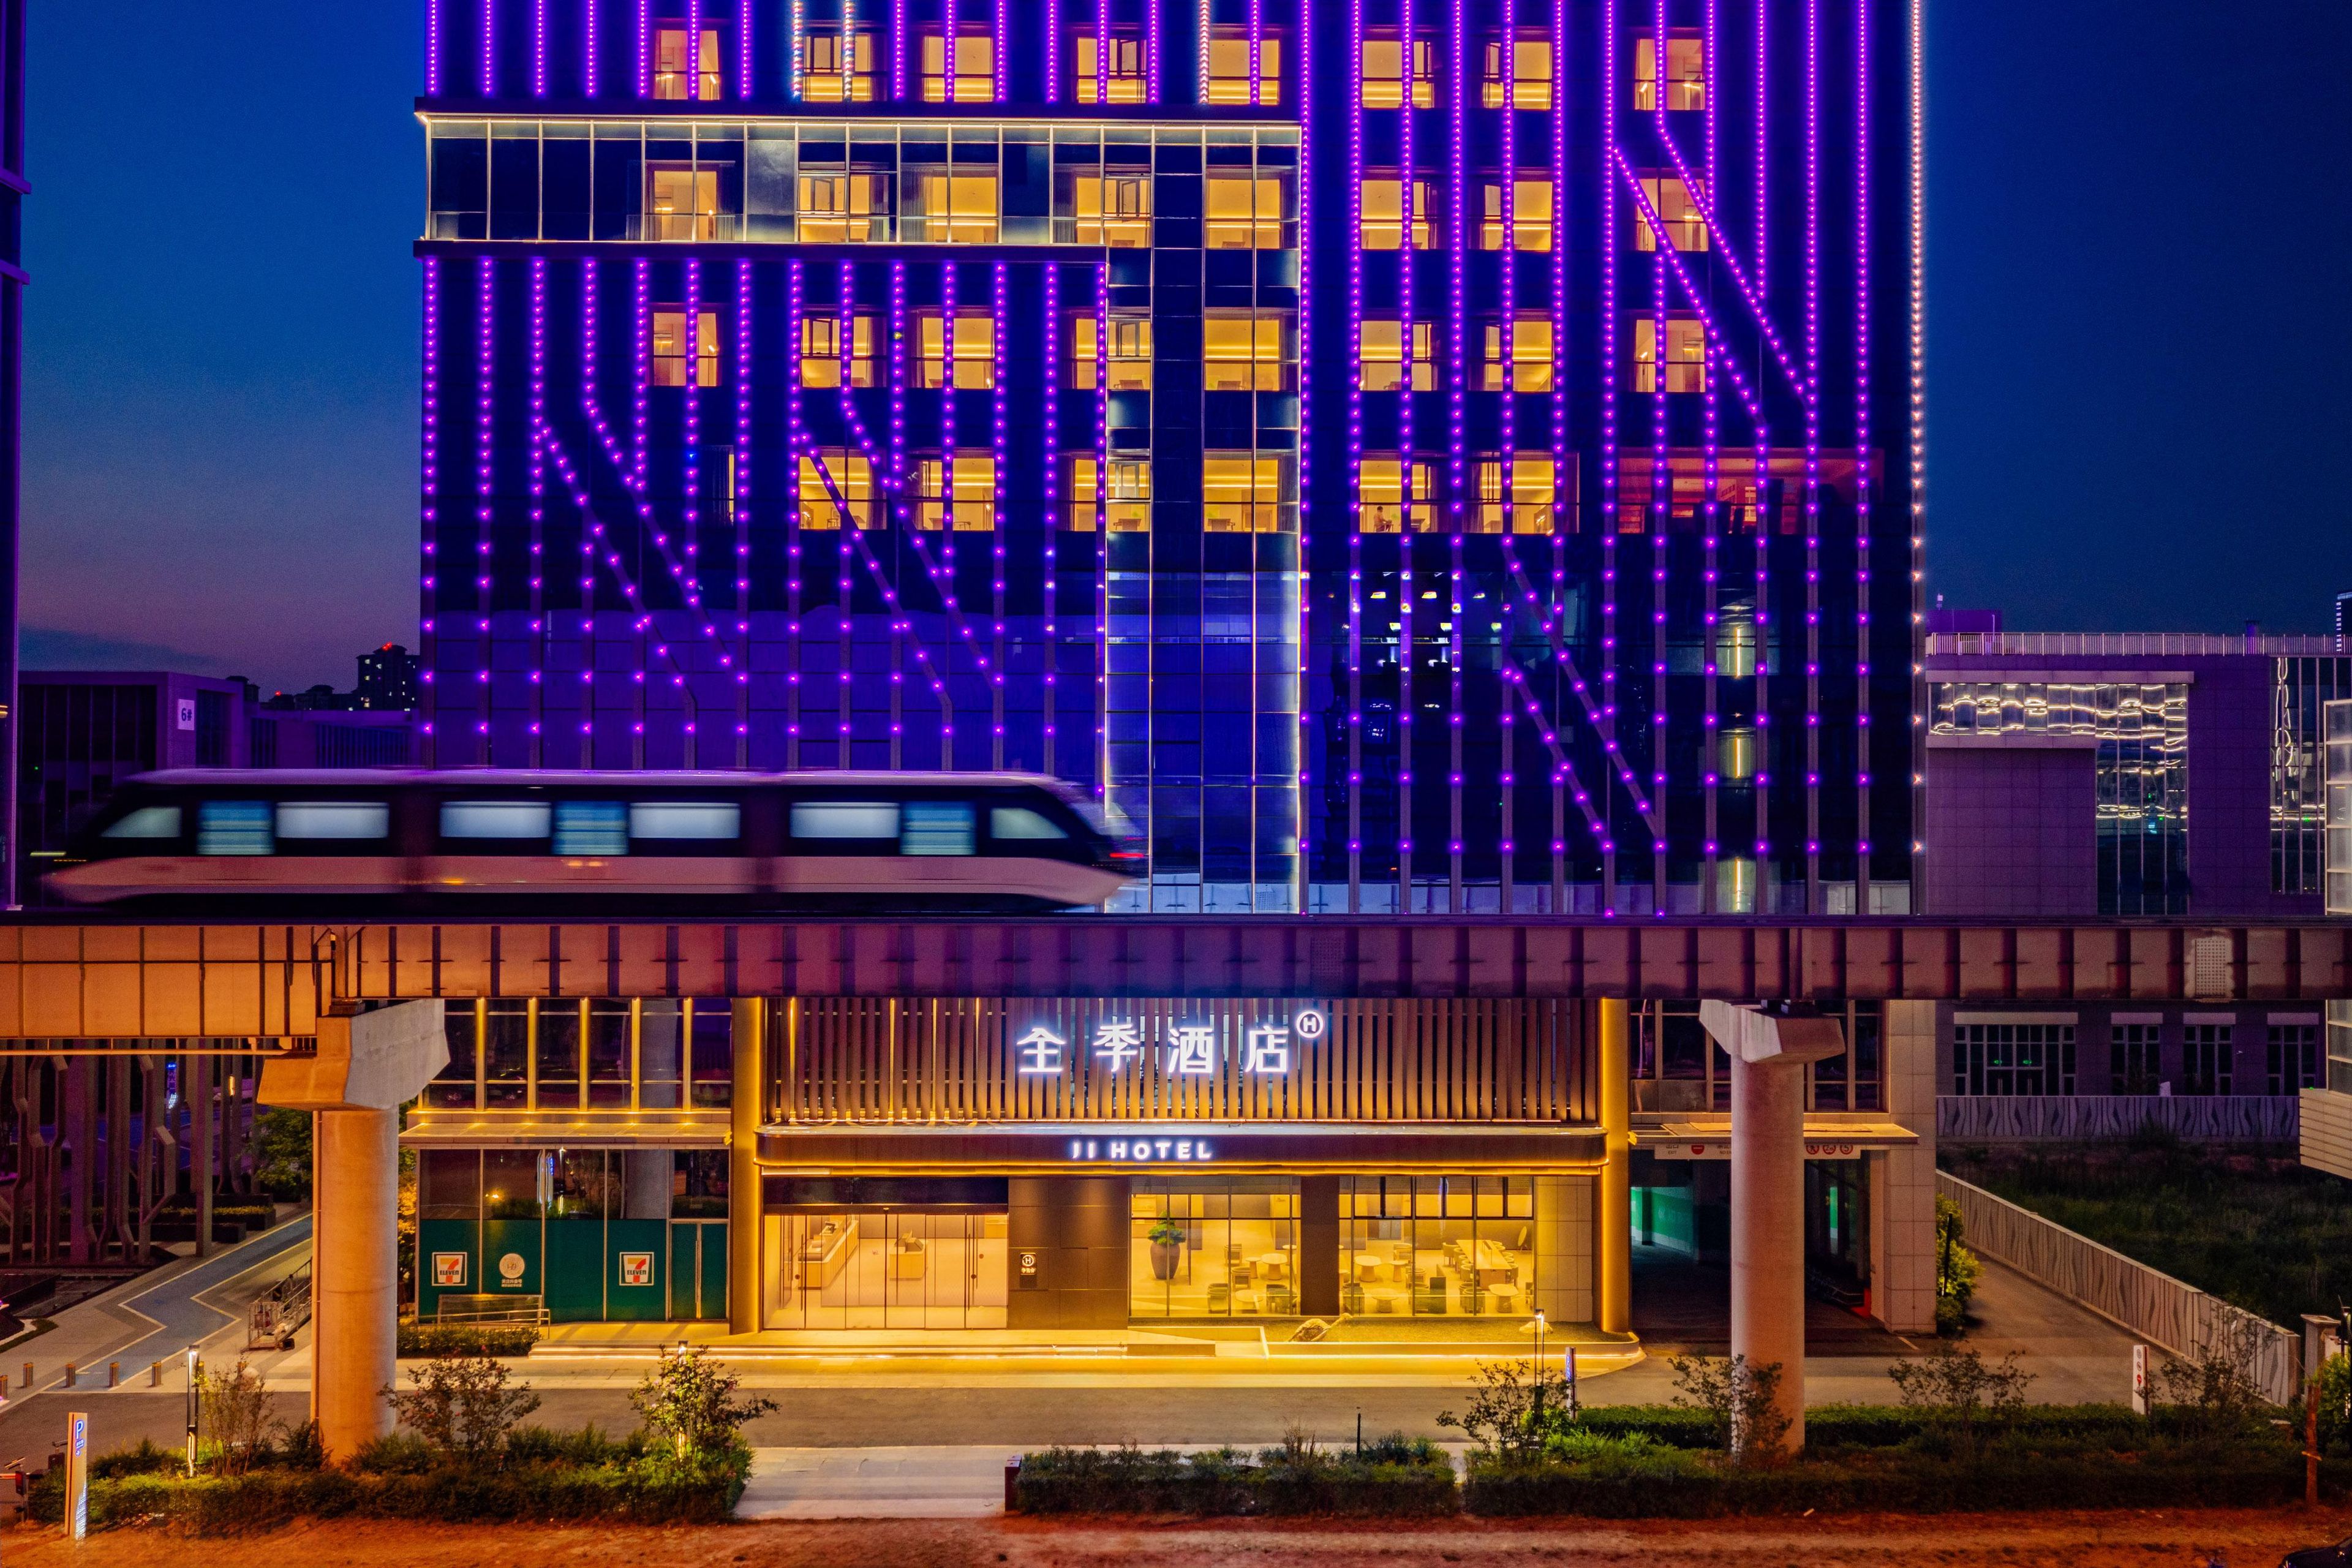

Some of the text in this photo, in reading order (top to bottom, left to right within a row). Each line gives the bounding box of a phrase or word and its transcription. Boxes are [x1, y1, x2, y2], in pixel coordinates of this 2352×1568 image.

[181, 707, 192, 722] 6#
[1017, 1023, 1289, 1074] 全季酒店
[1072, 1141, 1212, 1159] JI HOTEL
[76, 1420, 84, 1439] P
